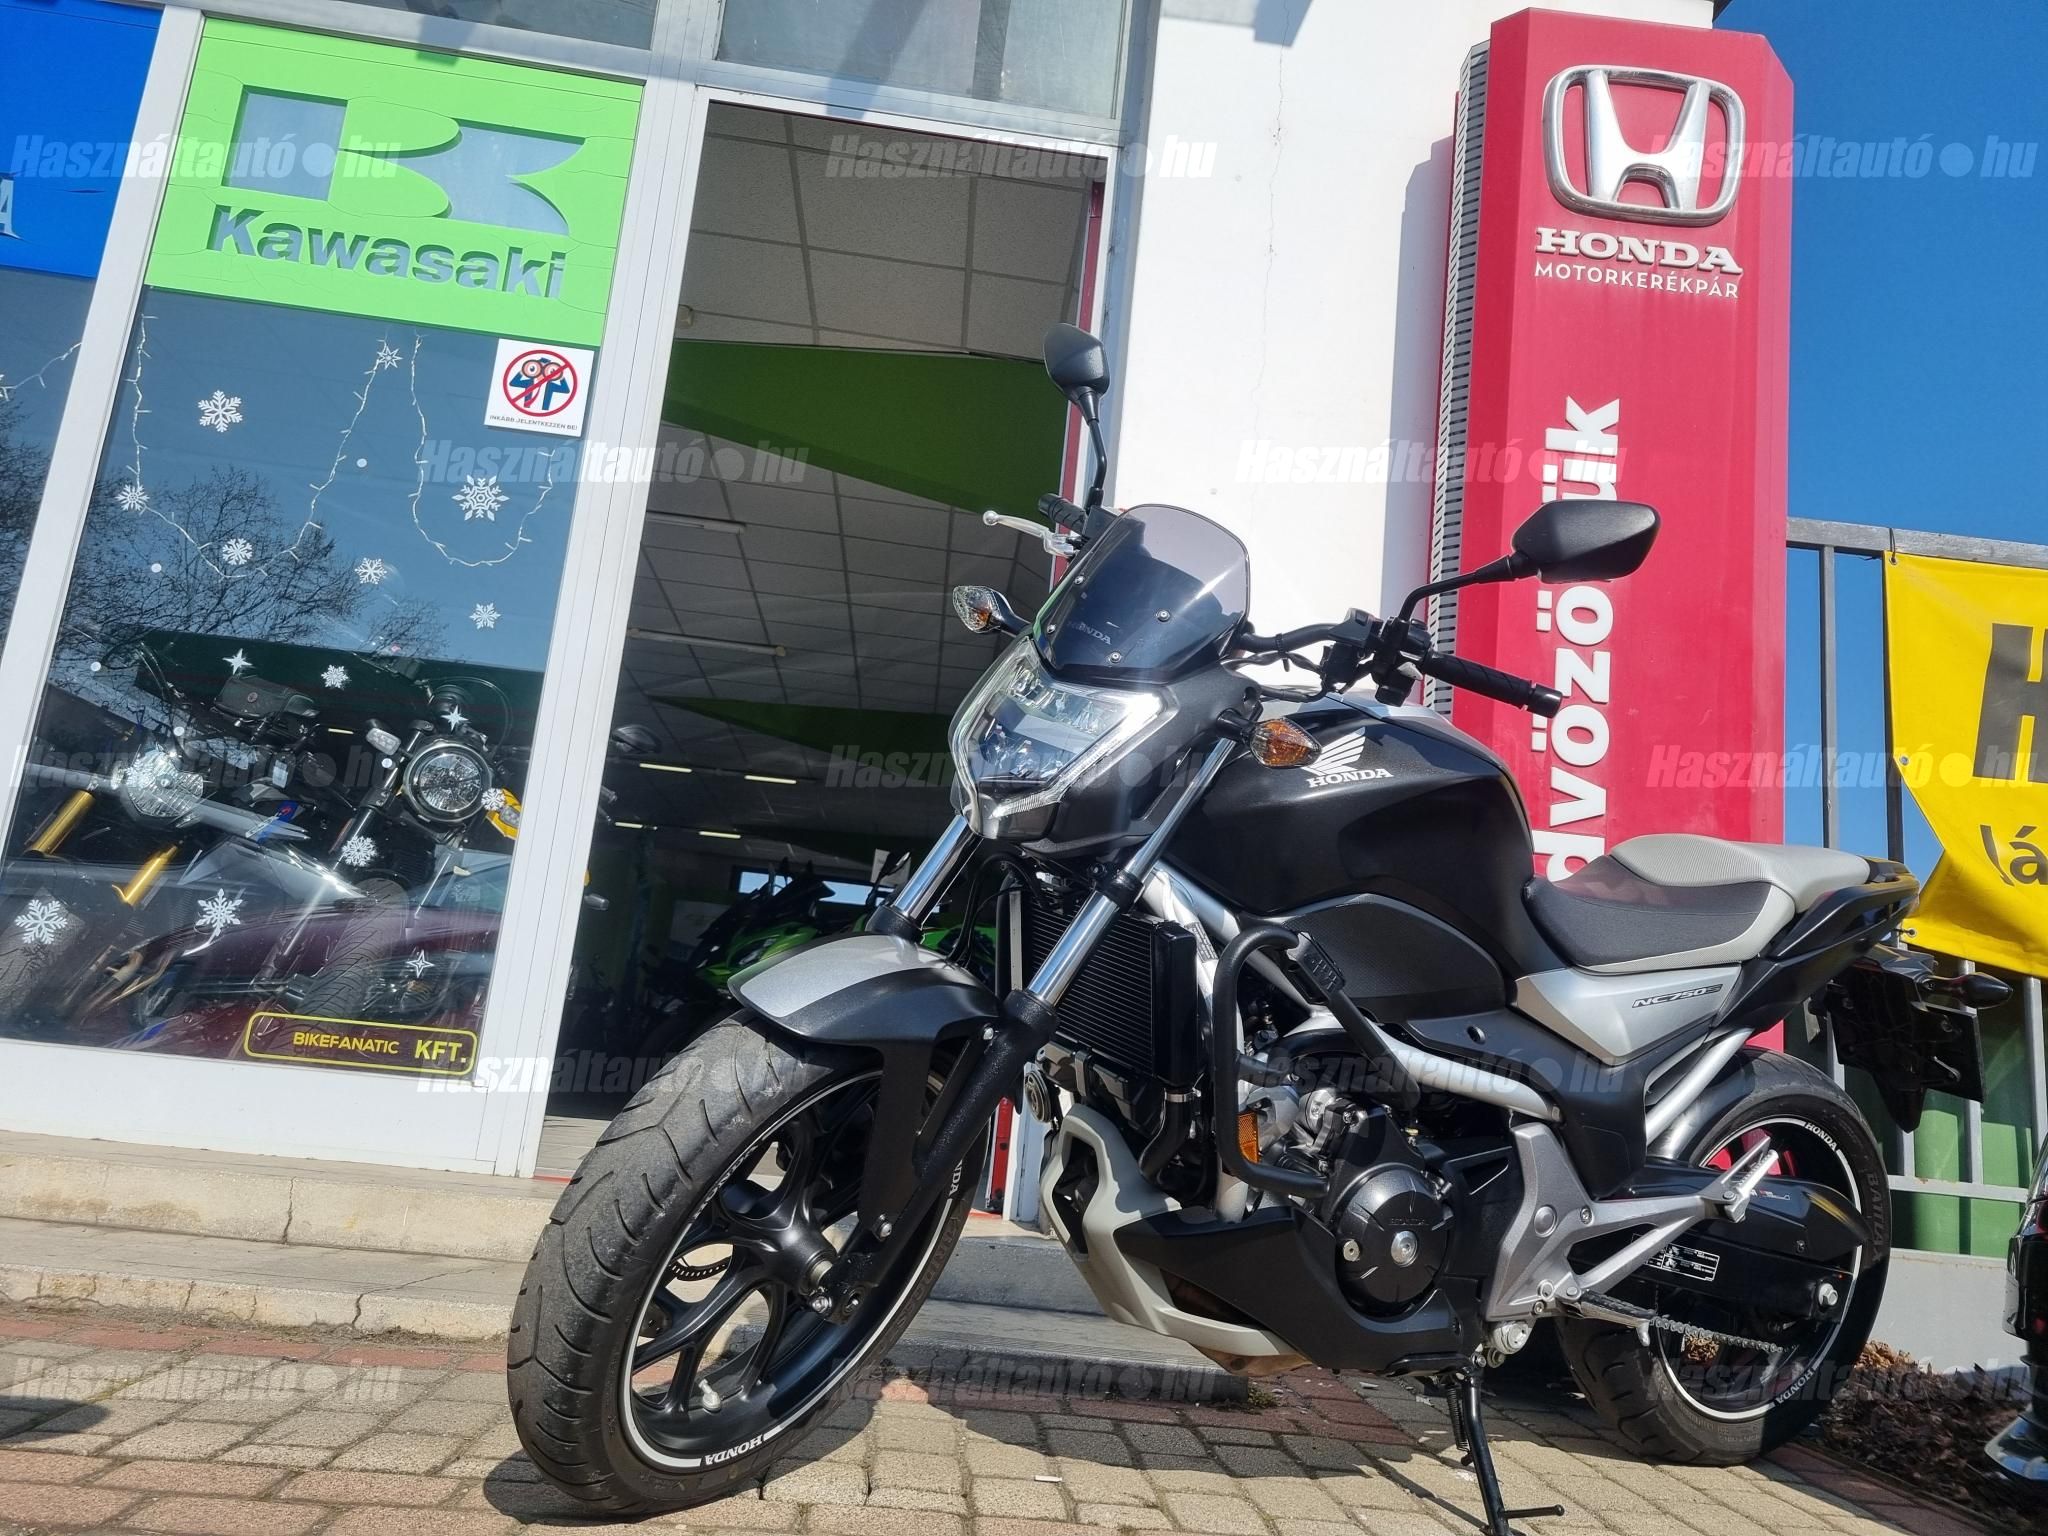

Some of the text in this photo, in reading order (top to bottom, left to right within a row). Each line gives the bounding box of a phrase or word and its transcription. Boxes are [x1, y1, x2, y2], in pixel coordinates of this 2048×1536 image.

[206, 205, 566, 299] Kawasaki
[1535, 227, 1743, 275] HONDA
[1534, 261, 1738, 298] MOTORKERÉKPÁR
[1067, 621, 1112, 645] ONDA
[1306, 768, 1395, 788] HONDA
[293, 1031, 467, 1063] BIKEFANATIC KFT.
[1805, 1122, 1838, 1151] HONDA
[1775, 1367, 1815, 1405] HONDA
[705, 1434, 763, 1466] HONDA
